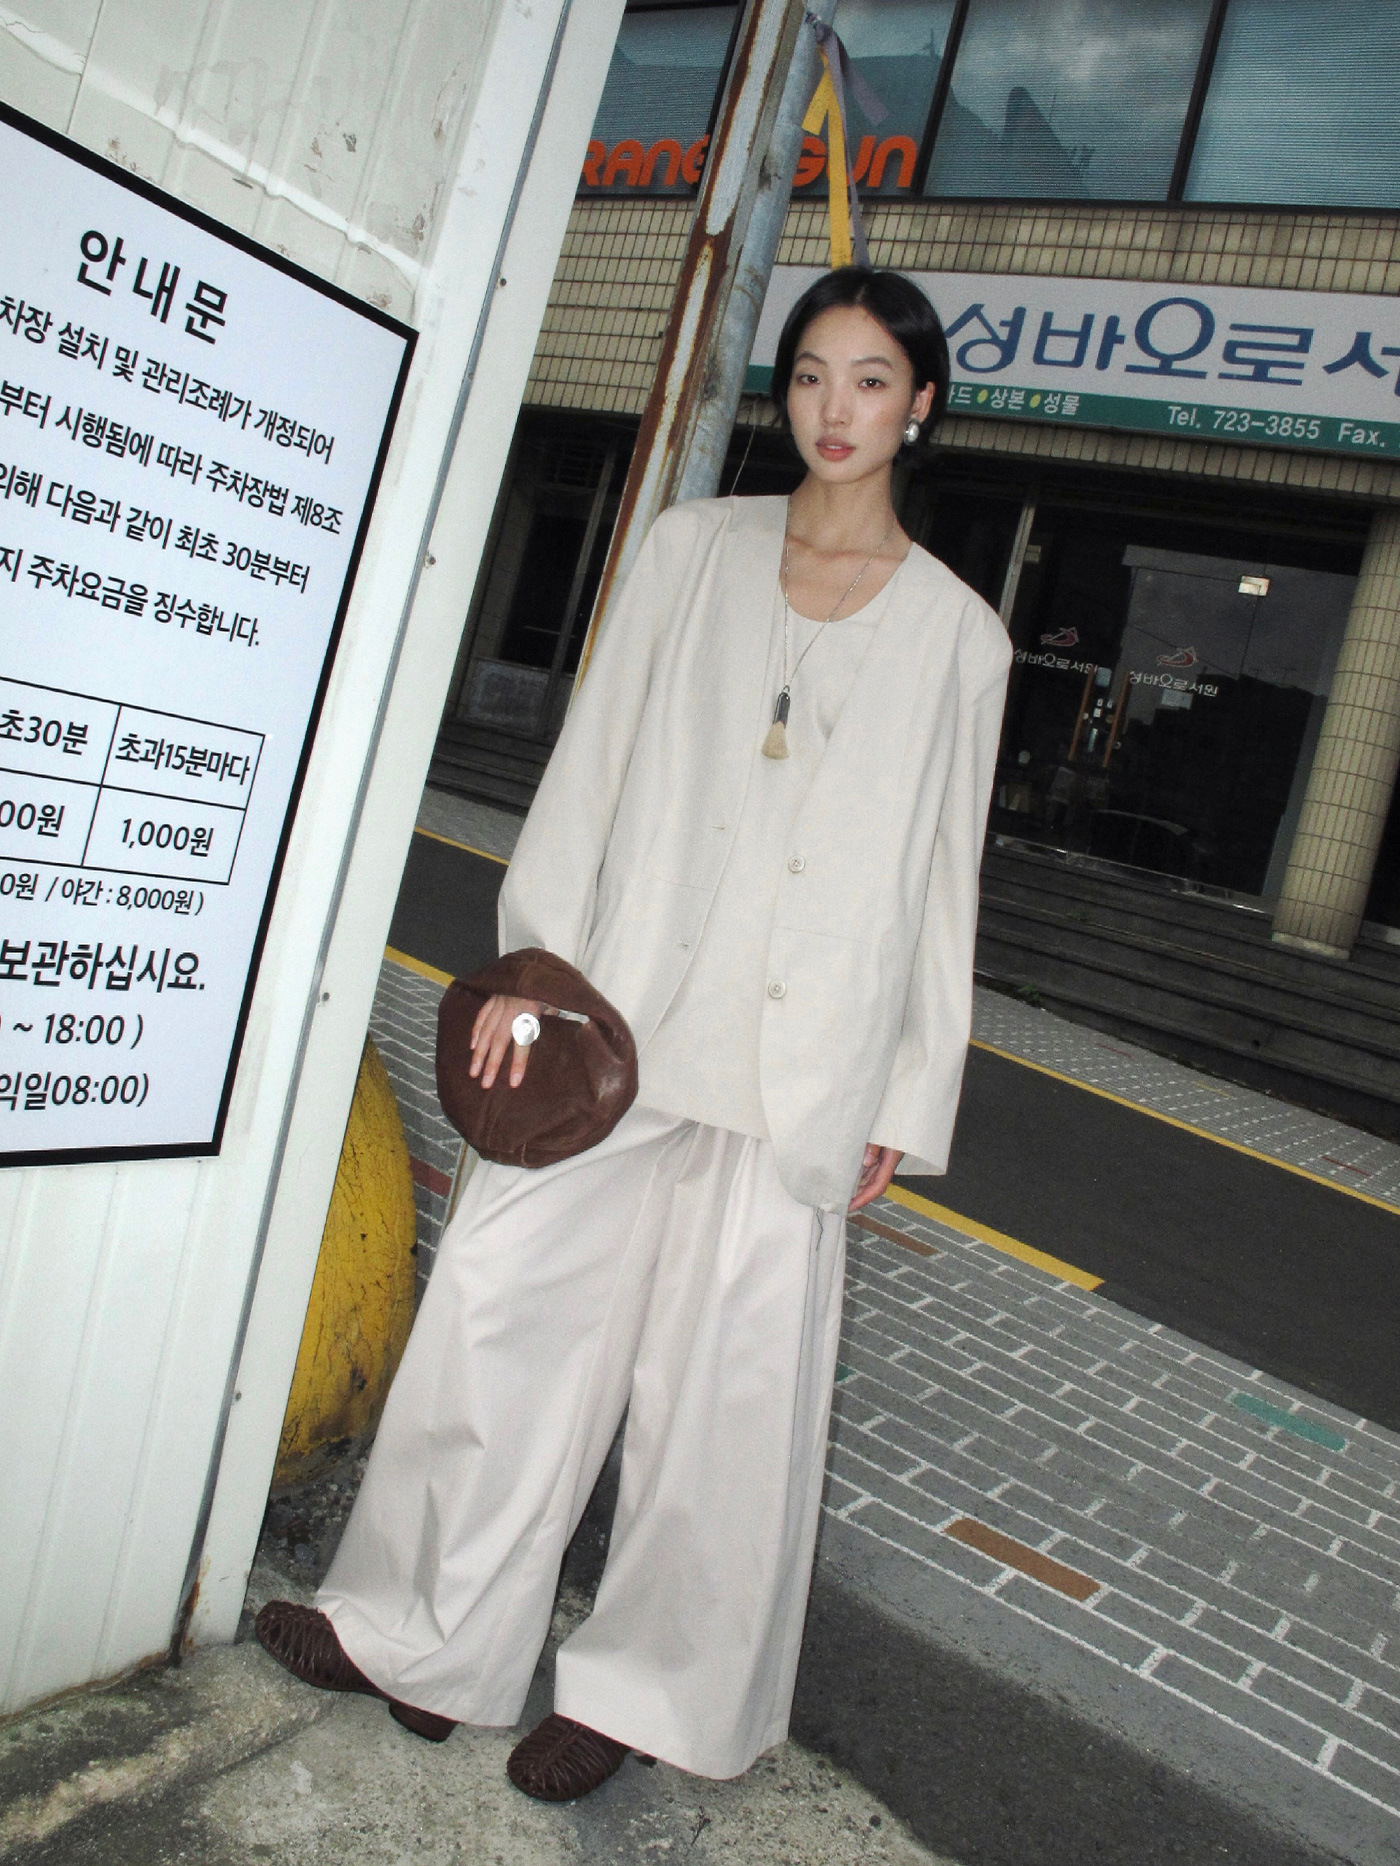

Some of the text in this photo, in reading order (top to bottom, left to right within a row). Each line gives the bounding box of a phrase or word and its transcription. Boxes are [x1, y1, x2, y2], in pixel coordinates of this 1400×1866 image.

[58, 321, 109, 371] 설치
[112, 345, 139, 383] 및
[141, 357, 252, 430] 관리조례가
[253, 405, 335, 465] 개정되어
[1167, 405, 1201, 429] Tel.
[1212, 410, 1321, 440] 723-3855
[1337, 422, 1386, 448] Fax.
[0, 380, 345, 535] 부터 시행됨에 따라 주차장법 제8조
[46, 481, 121, 533] 다음과
[125, 507, 173, 550] 같이
[174, 525, 220, 563] 최초
[221, 540, 311, 594] 30분부터
[27, 553, 149, 618] 주차요금을
[152, 590, 260, 647] 징수합니다.
[1129, 670, 1219, 697] 성바오로서원
[116, 733, 251, 786] 초과15분마다
[122, 817, 214, 857] 1,000원
